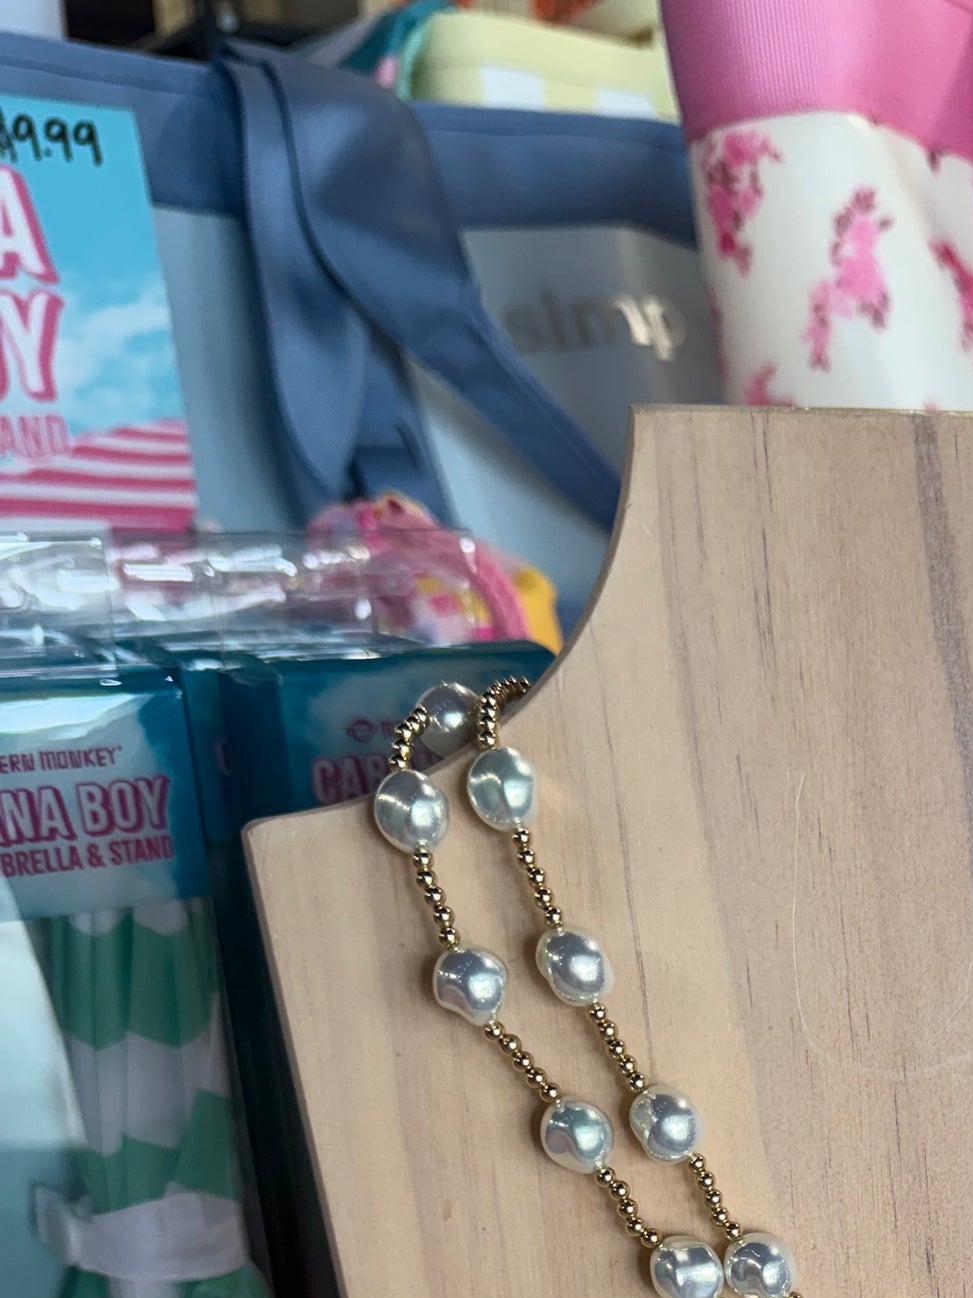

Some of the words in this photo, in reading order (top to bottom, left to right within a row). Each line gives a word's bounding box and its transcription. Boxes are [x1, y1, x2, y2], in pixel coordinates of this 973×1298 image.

[0, 287, 65, 402] Y
[38, 746, 117, 771] MONKEY
[75, 774, 170, 837] BOY
[1, 845, 84, 879] BRELLA
[87, 841, 107, 868] &
[108, 834, 174, 866] STAND
